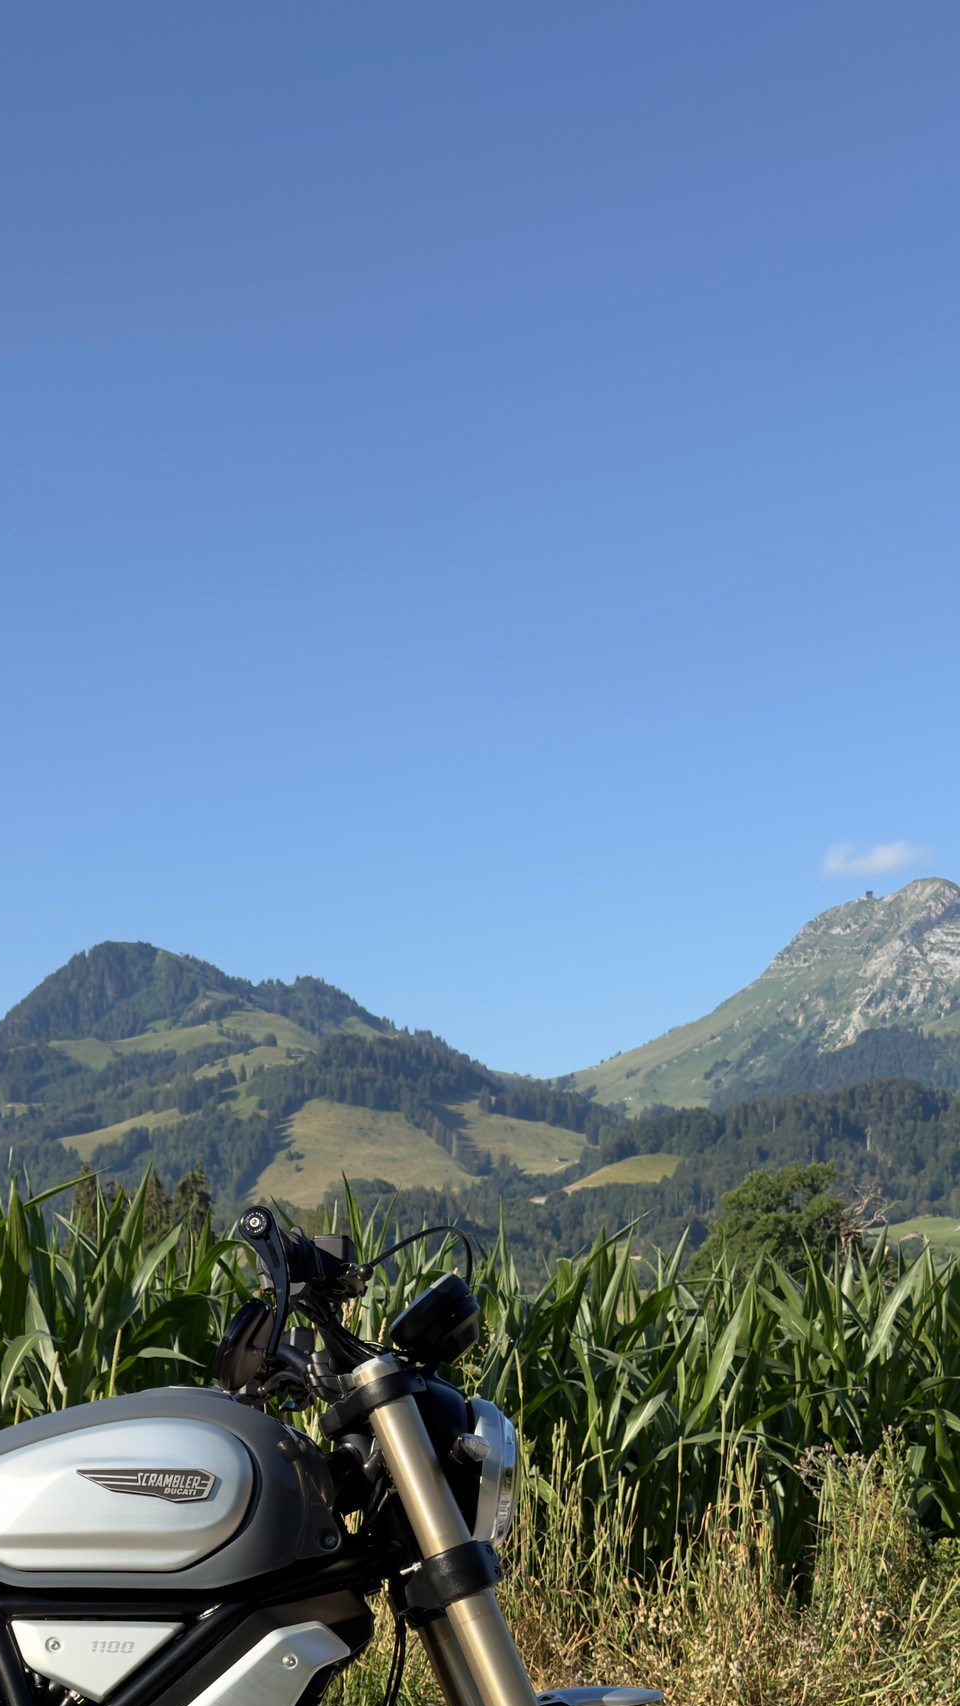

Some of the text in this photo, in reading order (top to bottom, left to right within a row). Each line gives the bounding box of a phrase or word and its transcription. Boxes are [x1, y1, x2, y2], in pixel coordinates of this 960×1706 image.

[137, 1472, 202, 1489] SCRAMBLER
[163, 1488, 197, 1496] DUCATI
[91, 1640, 135, 1653] 1100
